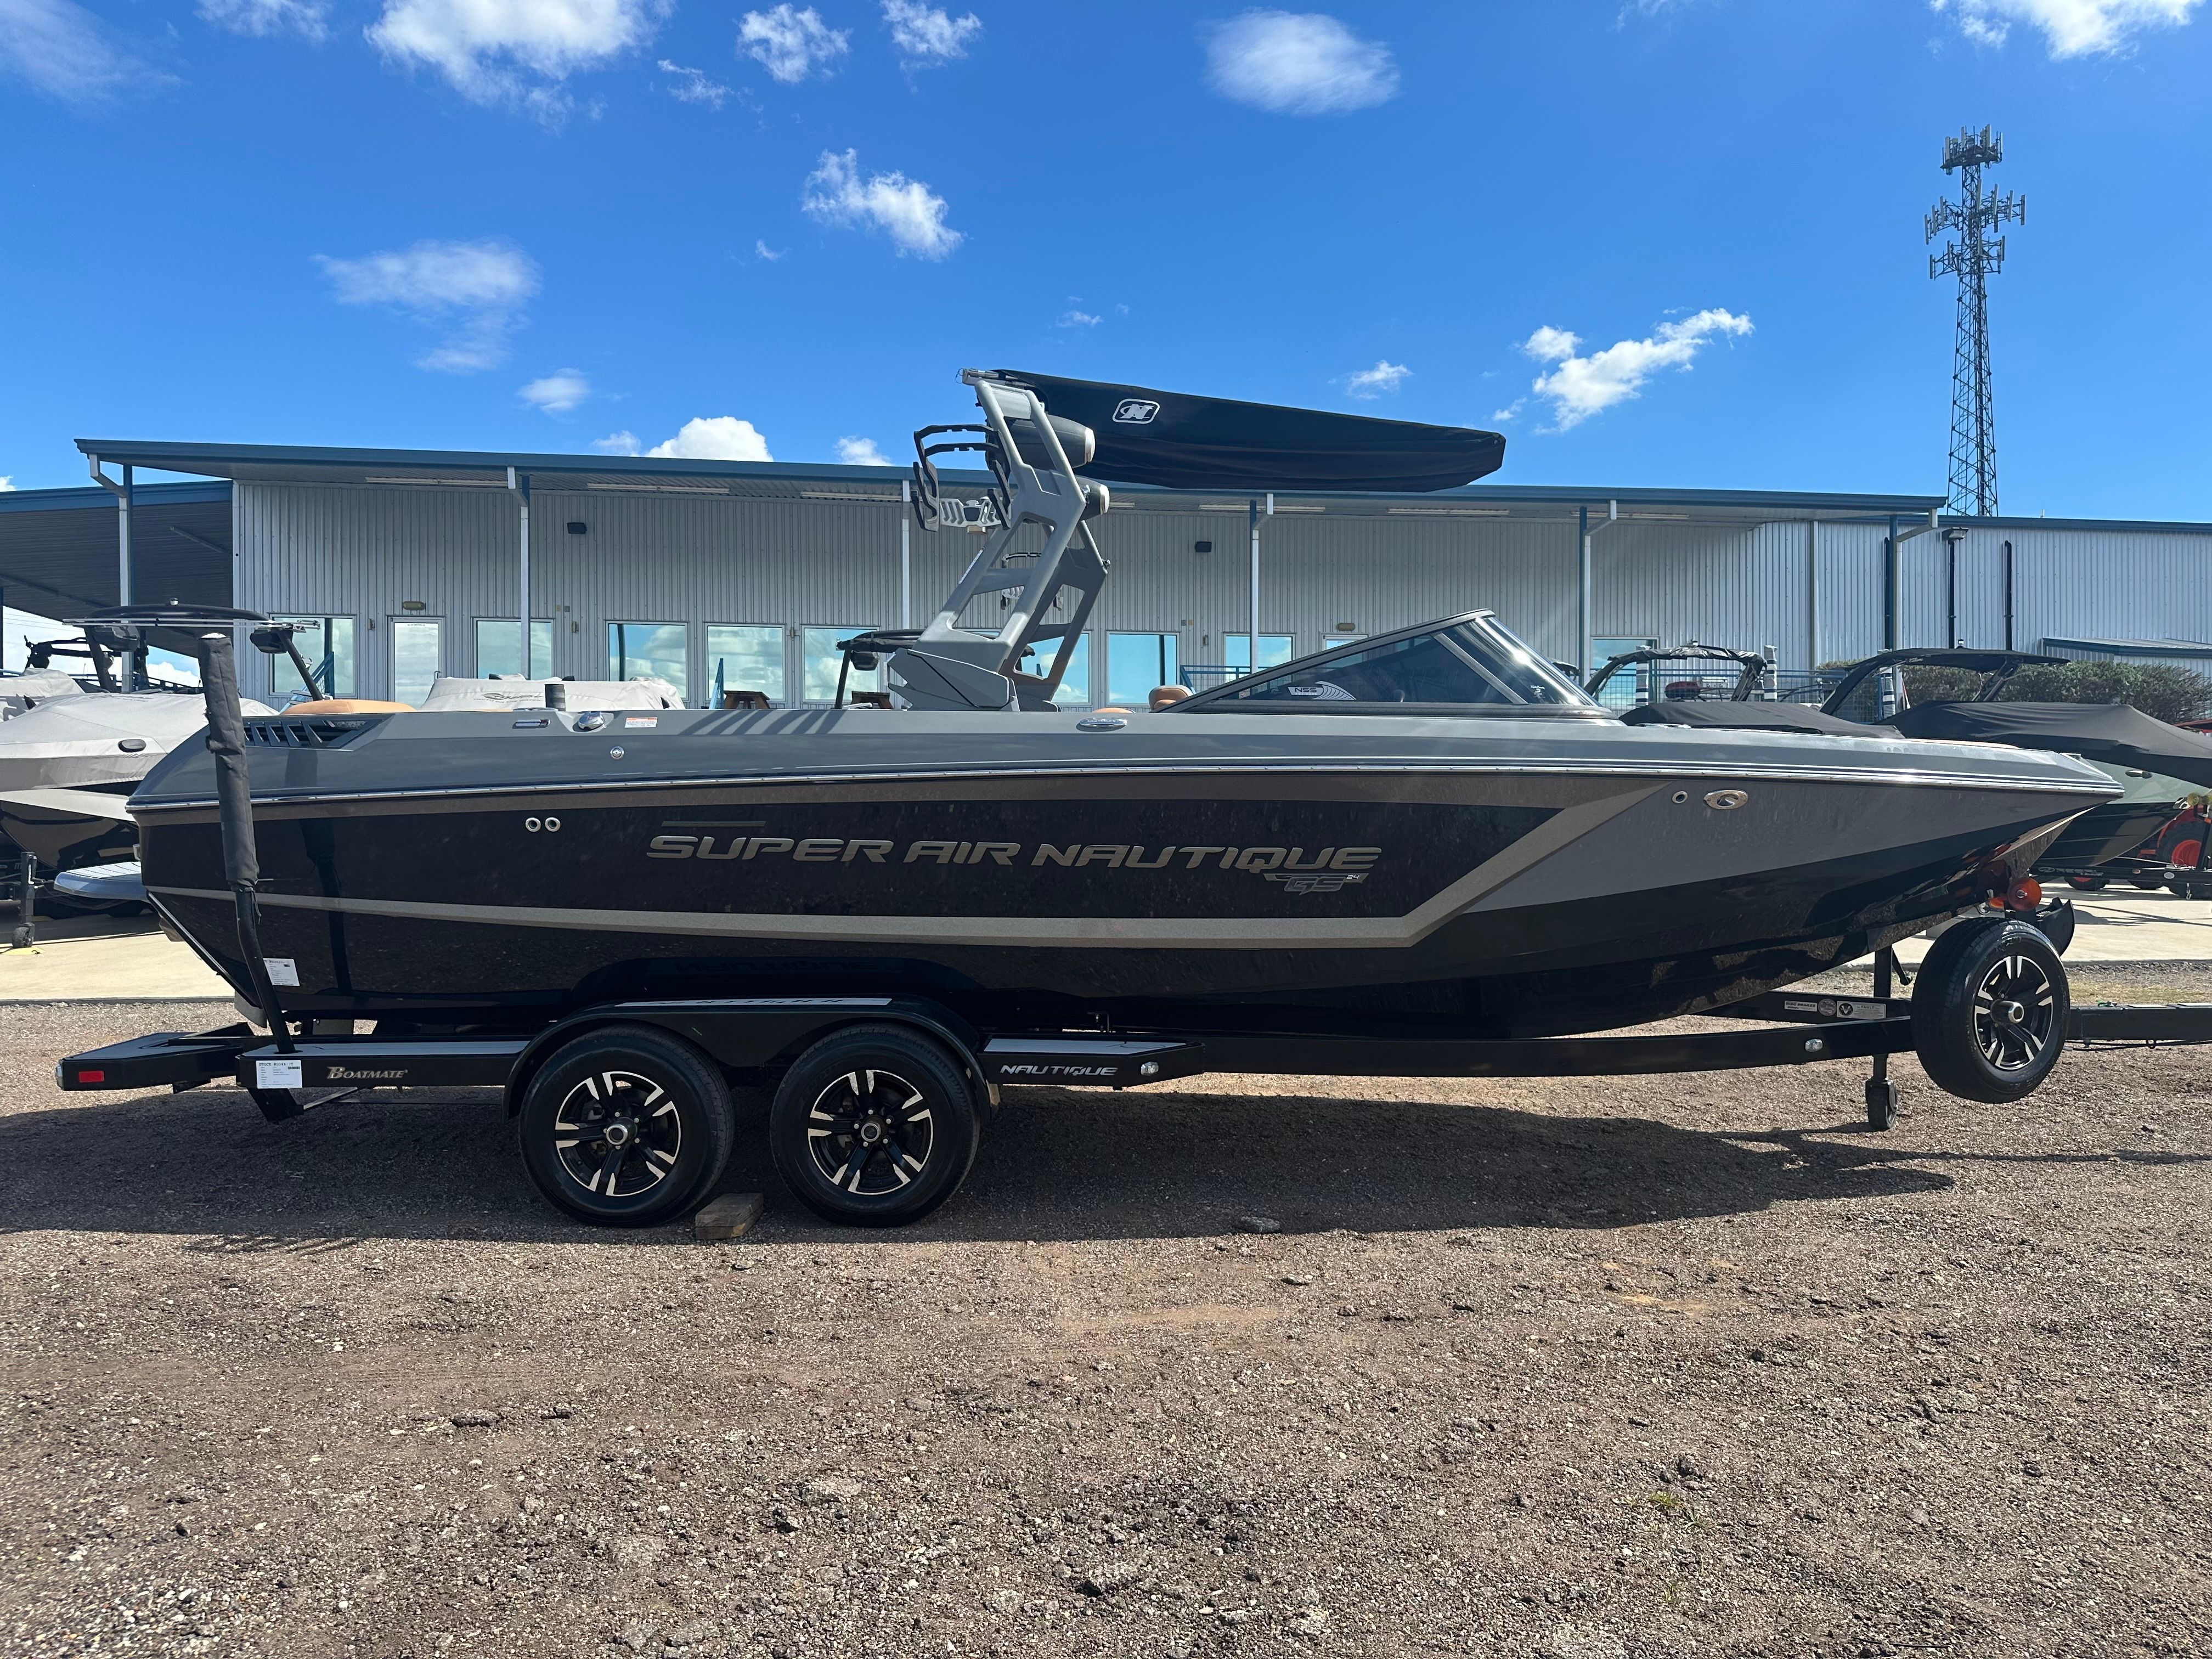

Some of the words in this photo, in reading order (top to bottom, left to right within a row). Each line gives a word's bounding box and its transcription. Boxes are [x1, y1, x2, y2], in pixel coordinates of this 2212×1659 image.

[646, 836, 894, 864] SUPER
[903, 840, 1021, 865] AIR
[1030, 843, 1382, 873] NAUTIQUE
[1000, 1065, 1118, 1076] NAUTIQUE
